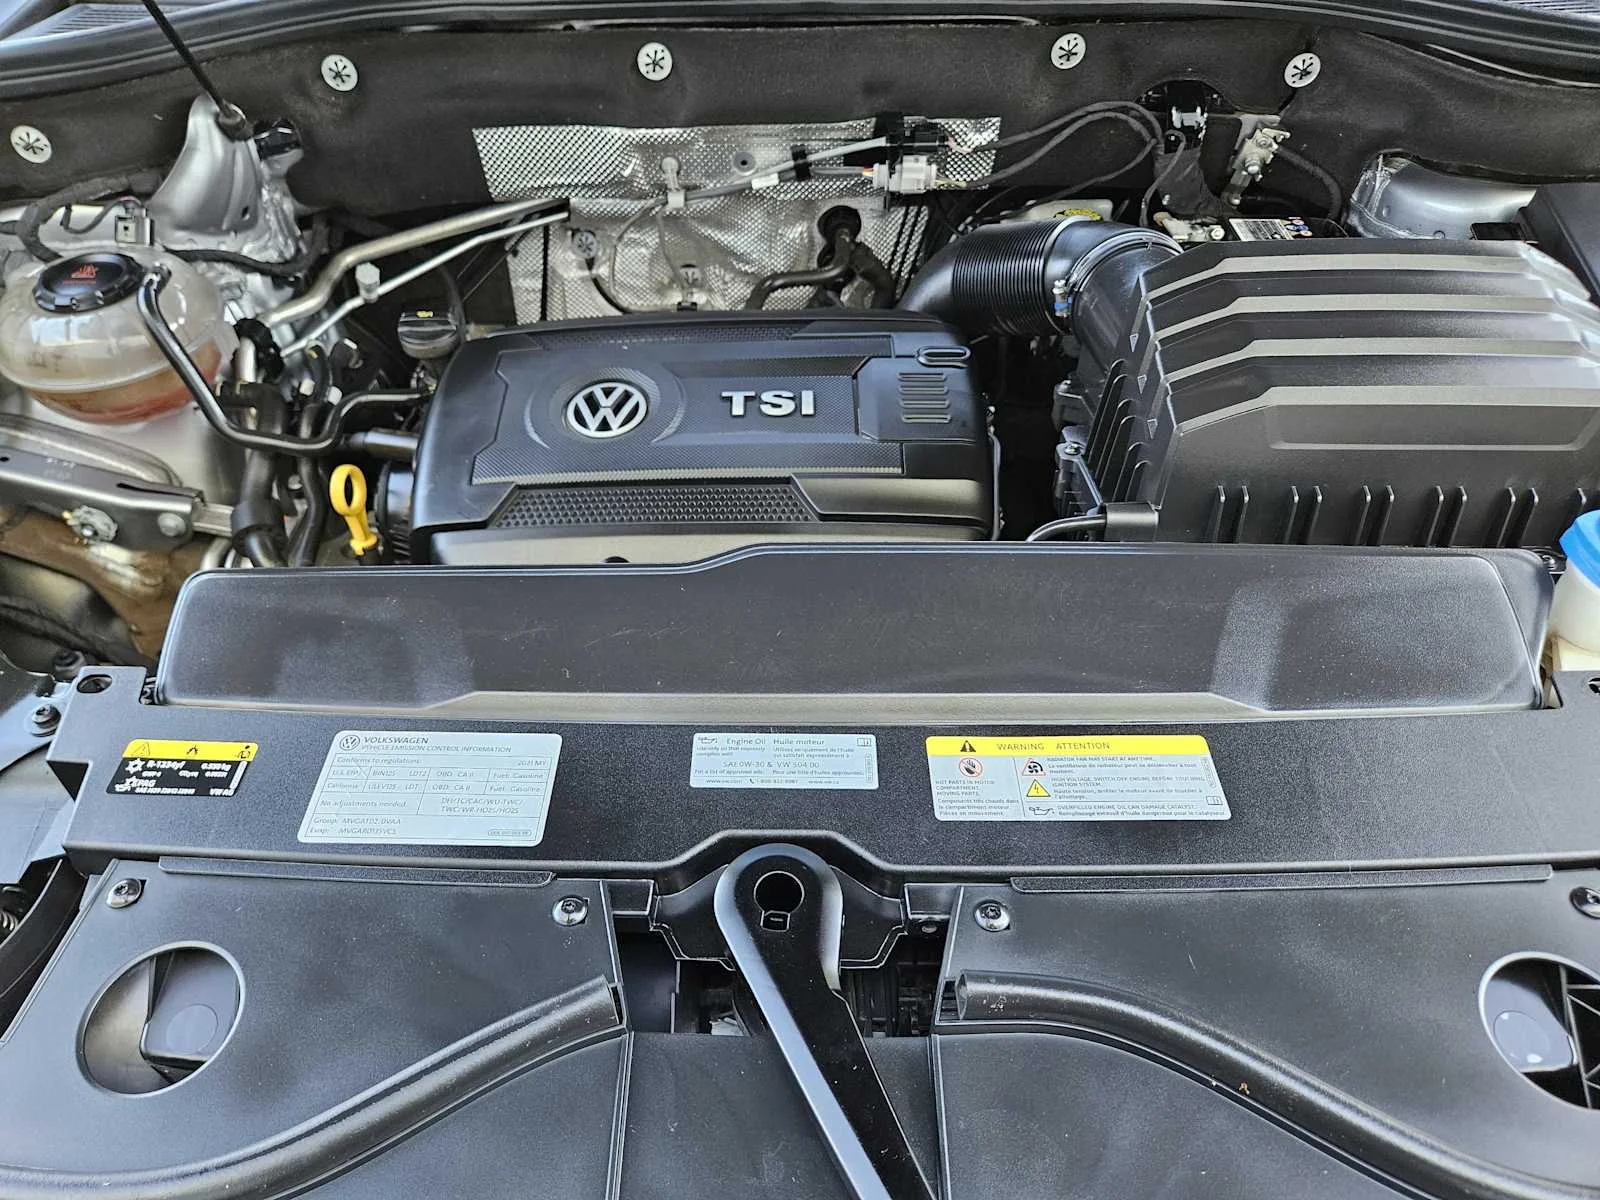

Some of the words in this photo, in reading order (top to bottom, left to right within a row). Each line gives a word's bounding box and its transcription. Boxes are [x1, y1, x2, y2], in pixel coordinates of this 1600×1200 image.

[721, 390, 815, 416] TSI
[727, 738, 753, 746] Engine
[755, 738, 765, 746] Oil
[774, 738, 793, 746] Huile
[796, 738, 824, 746] moteur
[1056, 742, 1110, 750] ATTENTION
[997, 742, 1045, 751] WARNING
